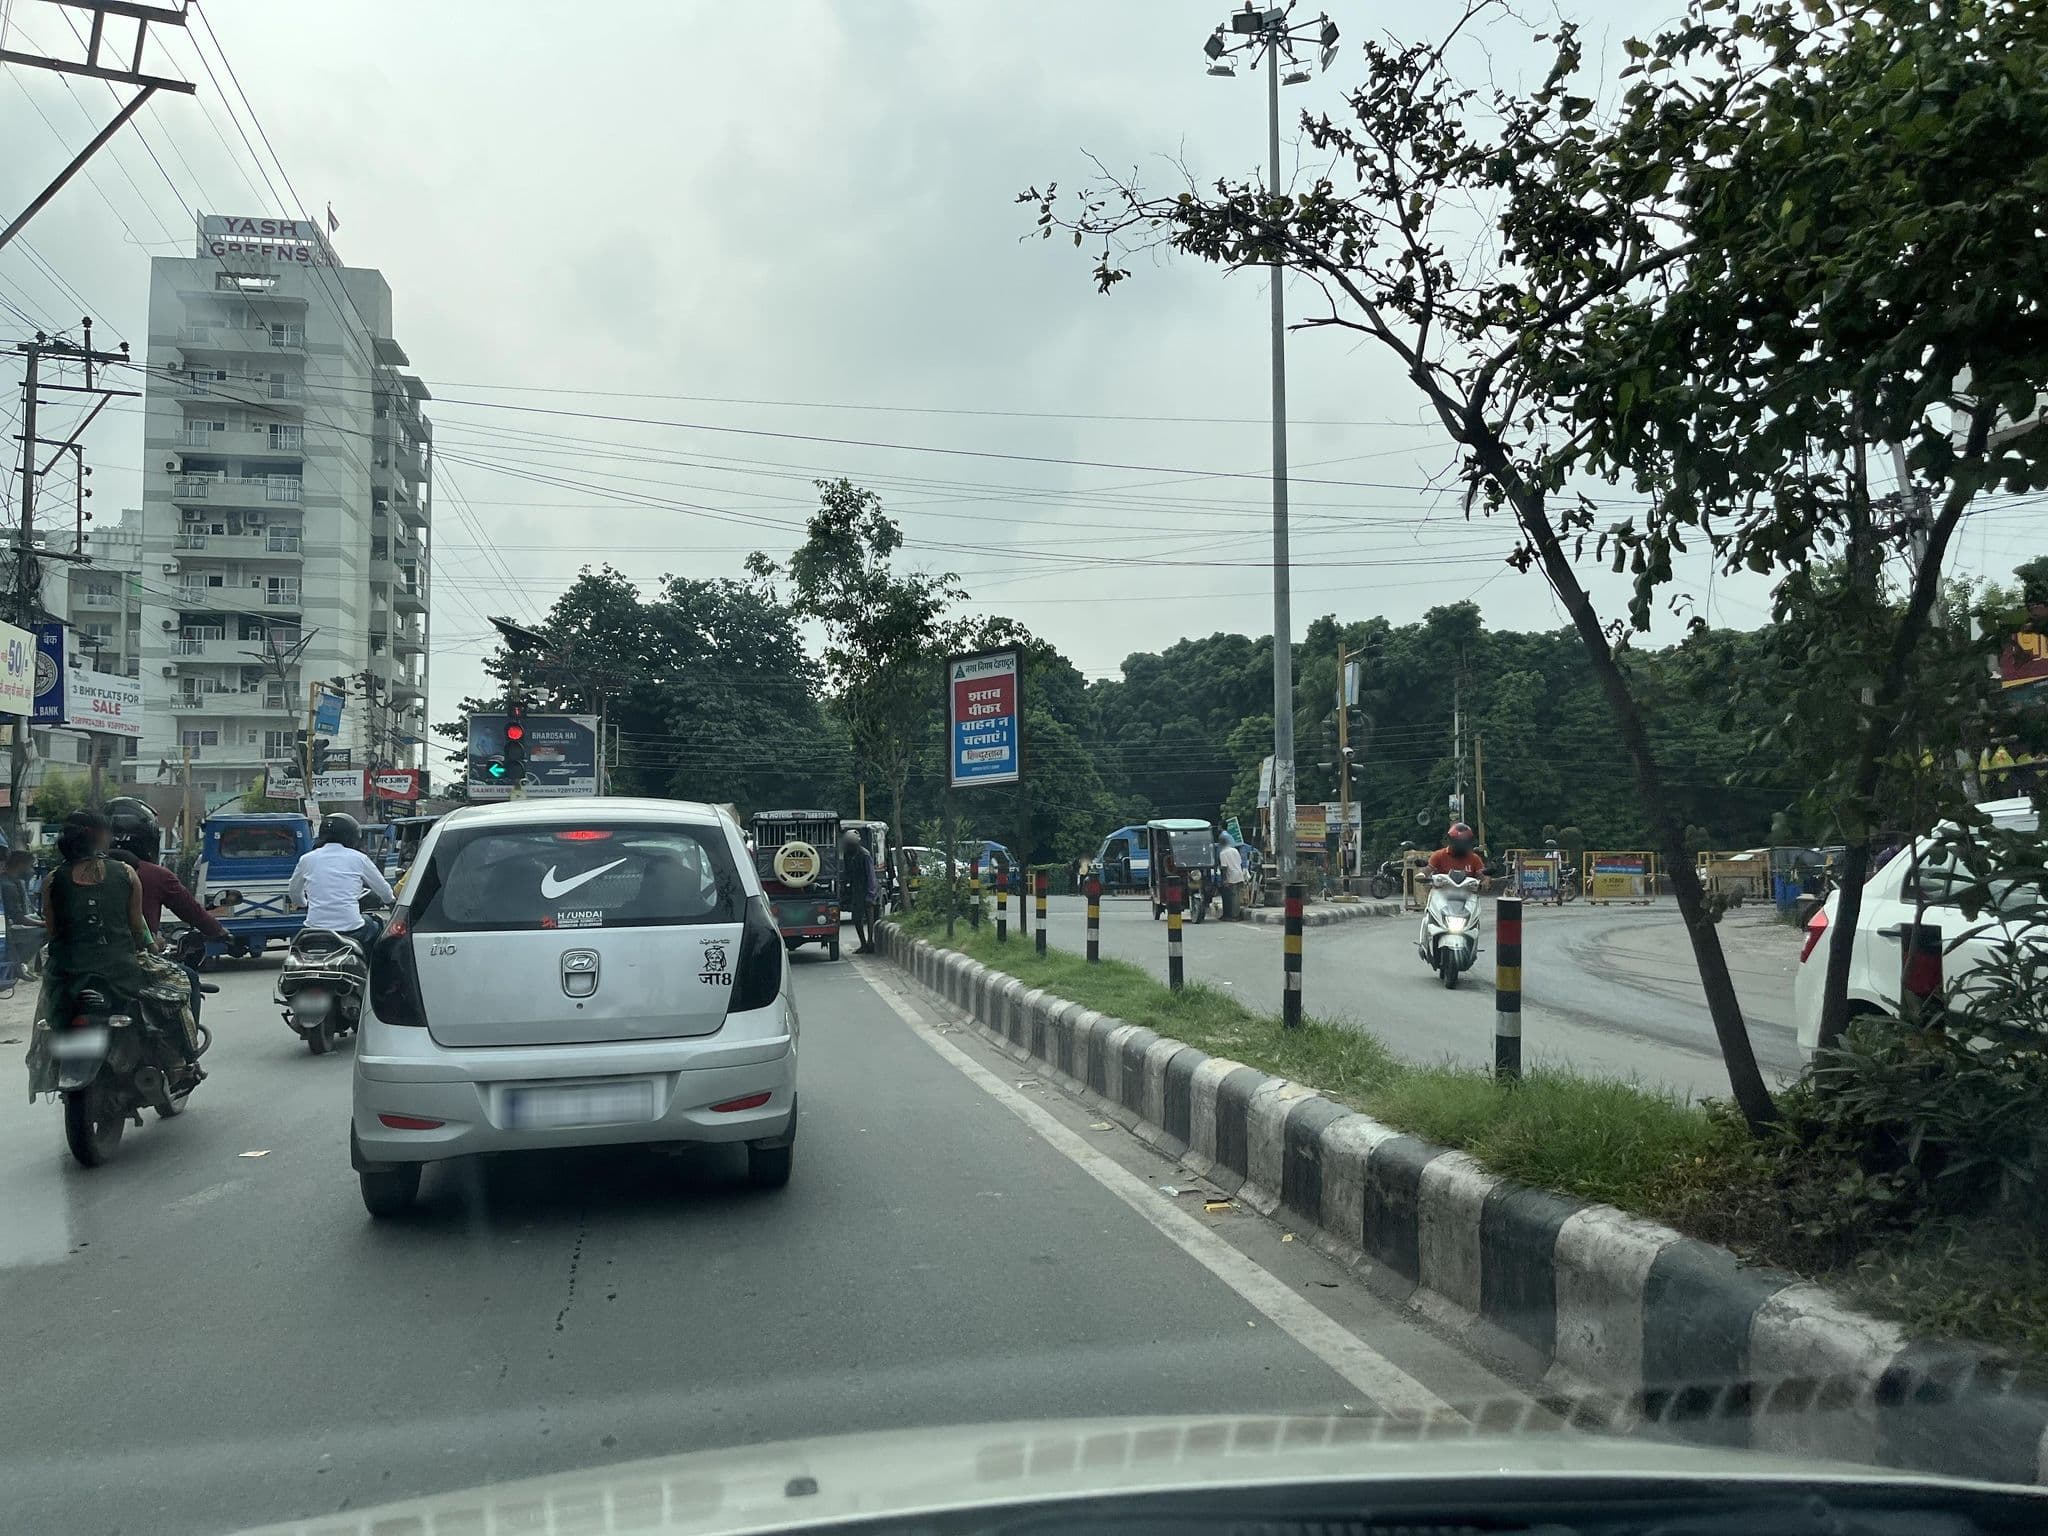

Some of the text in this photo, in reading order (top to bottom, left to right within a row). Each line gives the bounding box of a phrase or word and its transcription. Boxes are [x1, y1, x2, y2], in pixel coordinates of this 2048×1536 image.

[225, 217, 297, 236] YASH
[79, 685, 97, 697] BHK
[97, 688, 122, 702] FLATS
[123, 692, 139, 704] FOR
[39, 706, 59, 717] BANK
[92, 699, 121, 716] SALE
[968, 702, 1001, 716] पीकर
[960, 716, 1009, 731] वाहन न
